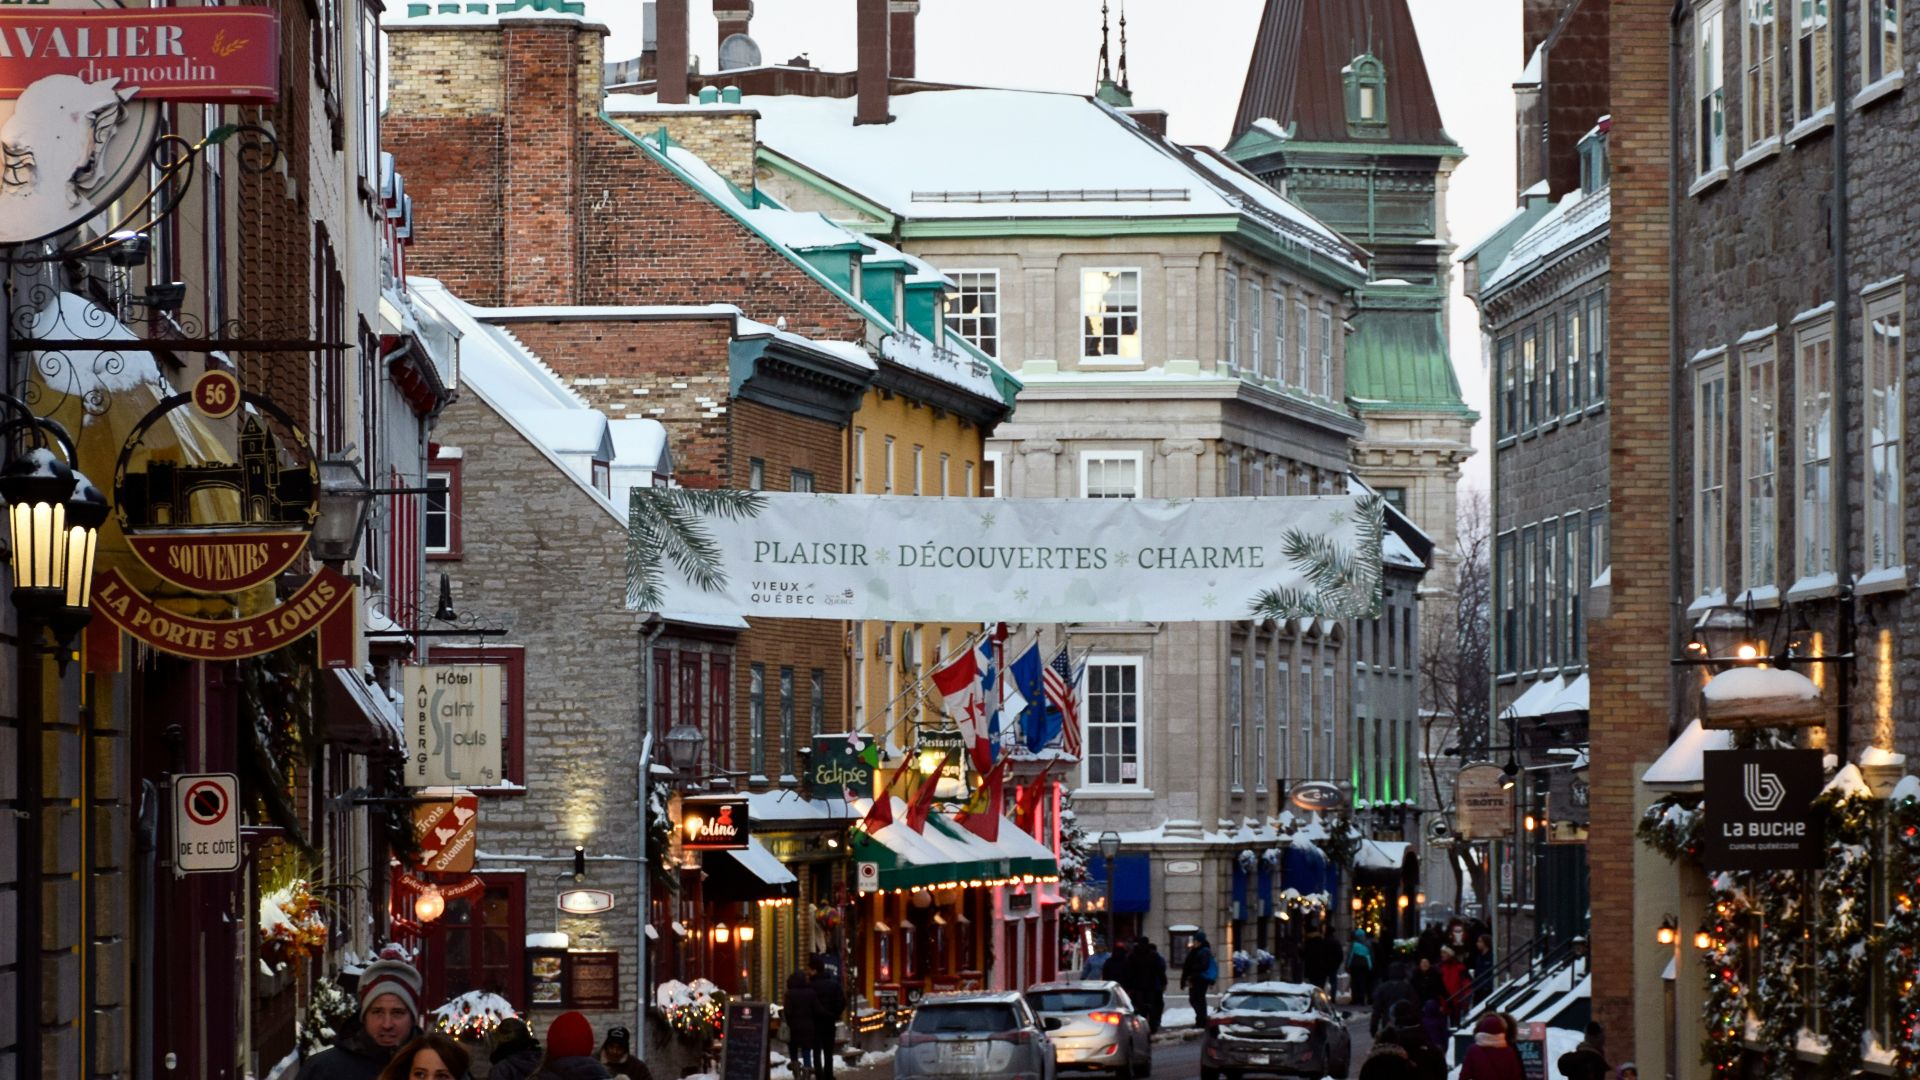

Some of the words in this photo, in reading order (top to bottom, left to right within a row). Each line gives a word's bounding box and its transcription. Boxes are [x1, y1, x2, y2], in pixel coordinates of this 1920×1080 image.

[78, 61, 111, 83] du
[122, 57, 216, 82] moulin
[206, 383, 226, 405] 56
[168, 543, 269, 581] SOUVENIRS
[754, 541, 869, 566] PLAISIR
[898, 541, 1108, 569] DÉCOUVERTES
[1138, 546, 1264, 569] CHARME
[751, 592, 815, 605] QUÉBEC
[752, 581, 800, 591] VIEUX
[100, 581, 127, 617] LA
[131, 606, 216, 650] PORTE
[436, 672, 473, 685] Hôtel
[417, 684, 428, 775] AUBERGE
[480, 766, 494, 780] 48
[416, 805, 444, 834] Trois
[687, 816, 738, 842] Polina
[181, 843, 193, 855] DE
[197, 842, 209, 855] CE
[212, 839, 235, 854] CÔTÉ
[436, 828, 475, 871] Colombes
